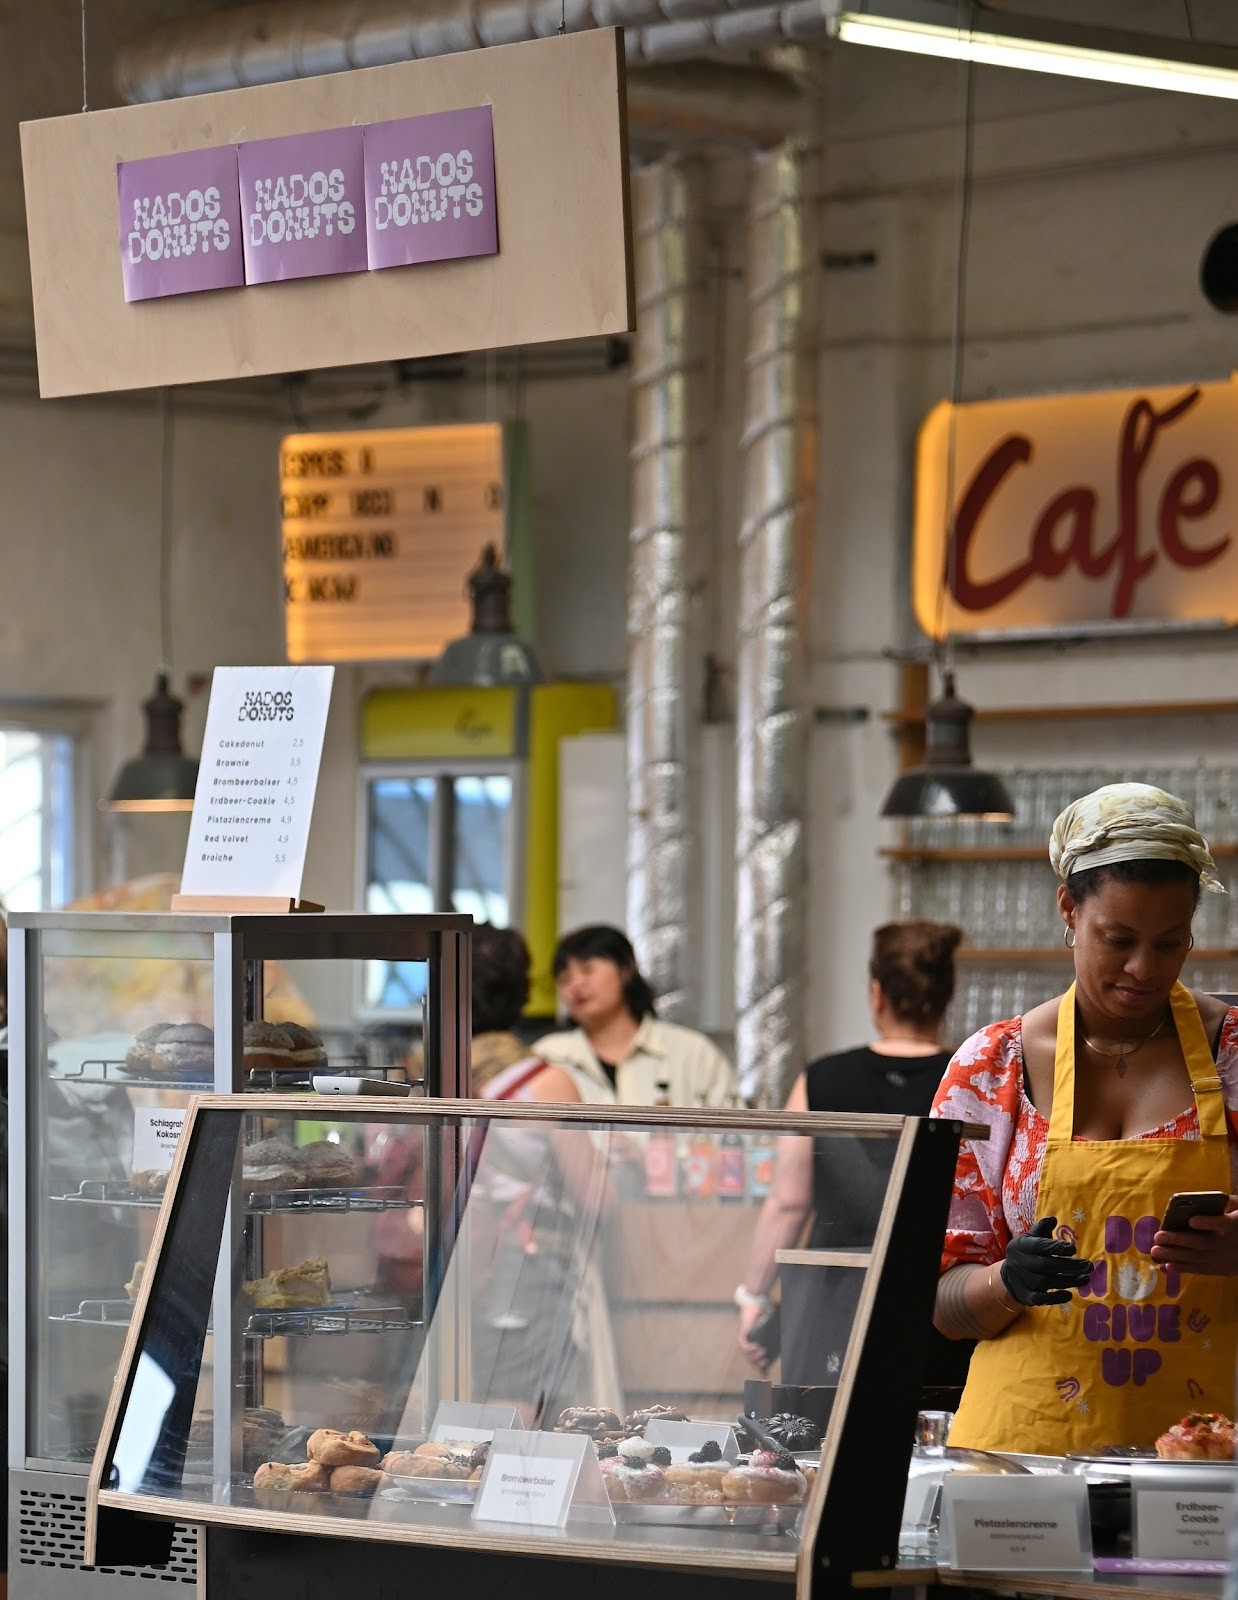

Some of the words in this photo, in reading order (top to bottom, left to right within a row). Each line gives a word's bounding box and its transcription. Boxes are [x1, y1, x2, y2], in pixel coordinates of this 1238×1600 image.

[380, 150, 473, 195] NADOS
[254, 168, 346, 213] NADOS
[133, 186, 221, 231] NADOS
[375, 183, 484, 231] DONUTS
[250, 201, 356, 247] DONUTS
[127, 218, 231, 265] DONUTS
[244, 691, 293, 706] NADOS
[238, 706, 295, 722] DONUTS
[219, 740, 265, 748] Cakedonut
[292, 738, 304, 748] 2,5
[216, 759, 249, 767] Brownie
[290, 757, 301, 768] 3,5
[213, 777, 281, 786] Brombeerbaiser
[286, 777, 298, 787] 4,5
[210, 796, 276, 805] Erdbeer-Cookie
[283, 796, 295, 806] 4,5
[207, 815, 272, 824] Pistaziencreme
[280, 815, 292, 825] 4,9
[204, 834, 220, 843] Red
[222, 834, 249, 843] Velvet
[277, 834, 289, 844] 4,9
[201, 853, 233, 862] Broiche
[274, 853, 286, 864] 5,5
[1105, 1215, 1161, 1254] DO
[1083, 1303, 1182, 1342] GIVE
[1102, 1347, 1162, 1387] UP
[501, 1474, 555, 1486] Brombeerbaiser
[1175, 1502, 1224, 1512] Erdbeer-
[974, 1518, 1058, 1530] Pistaziencreme
[1180, 1514, 1220, 1524] Cookie
